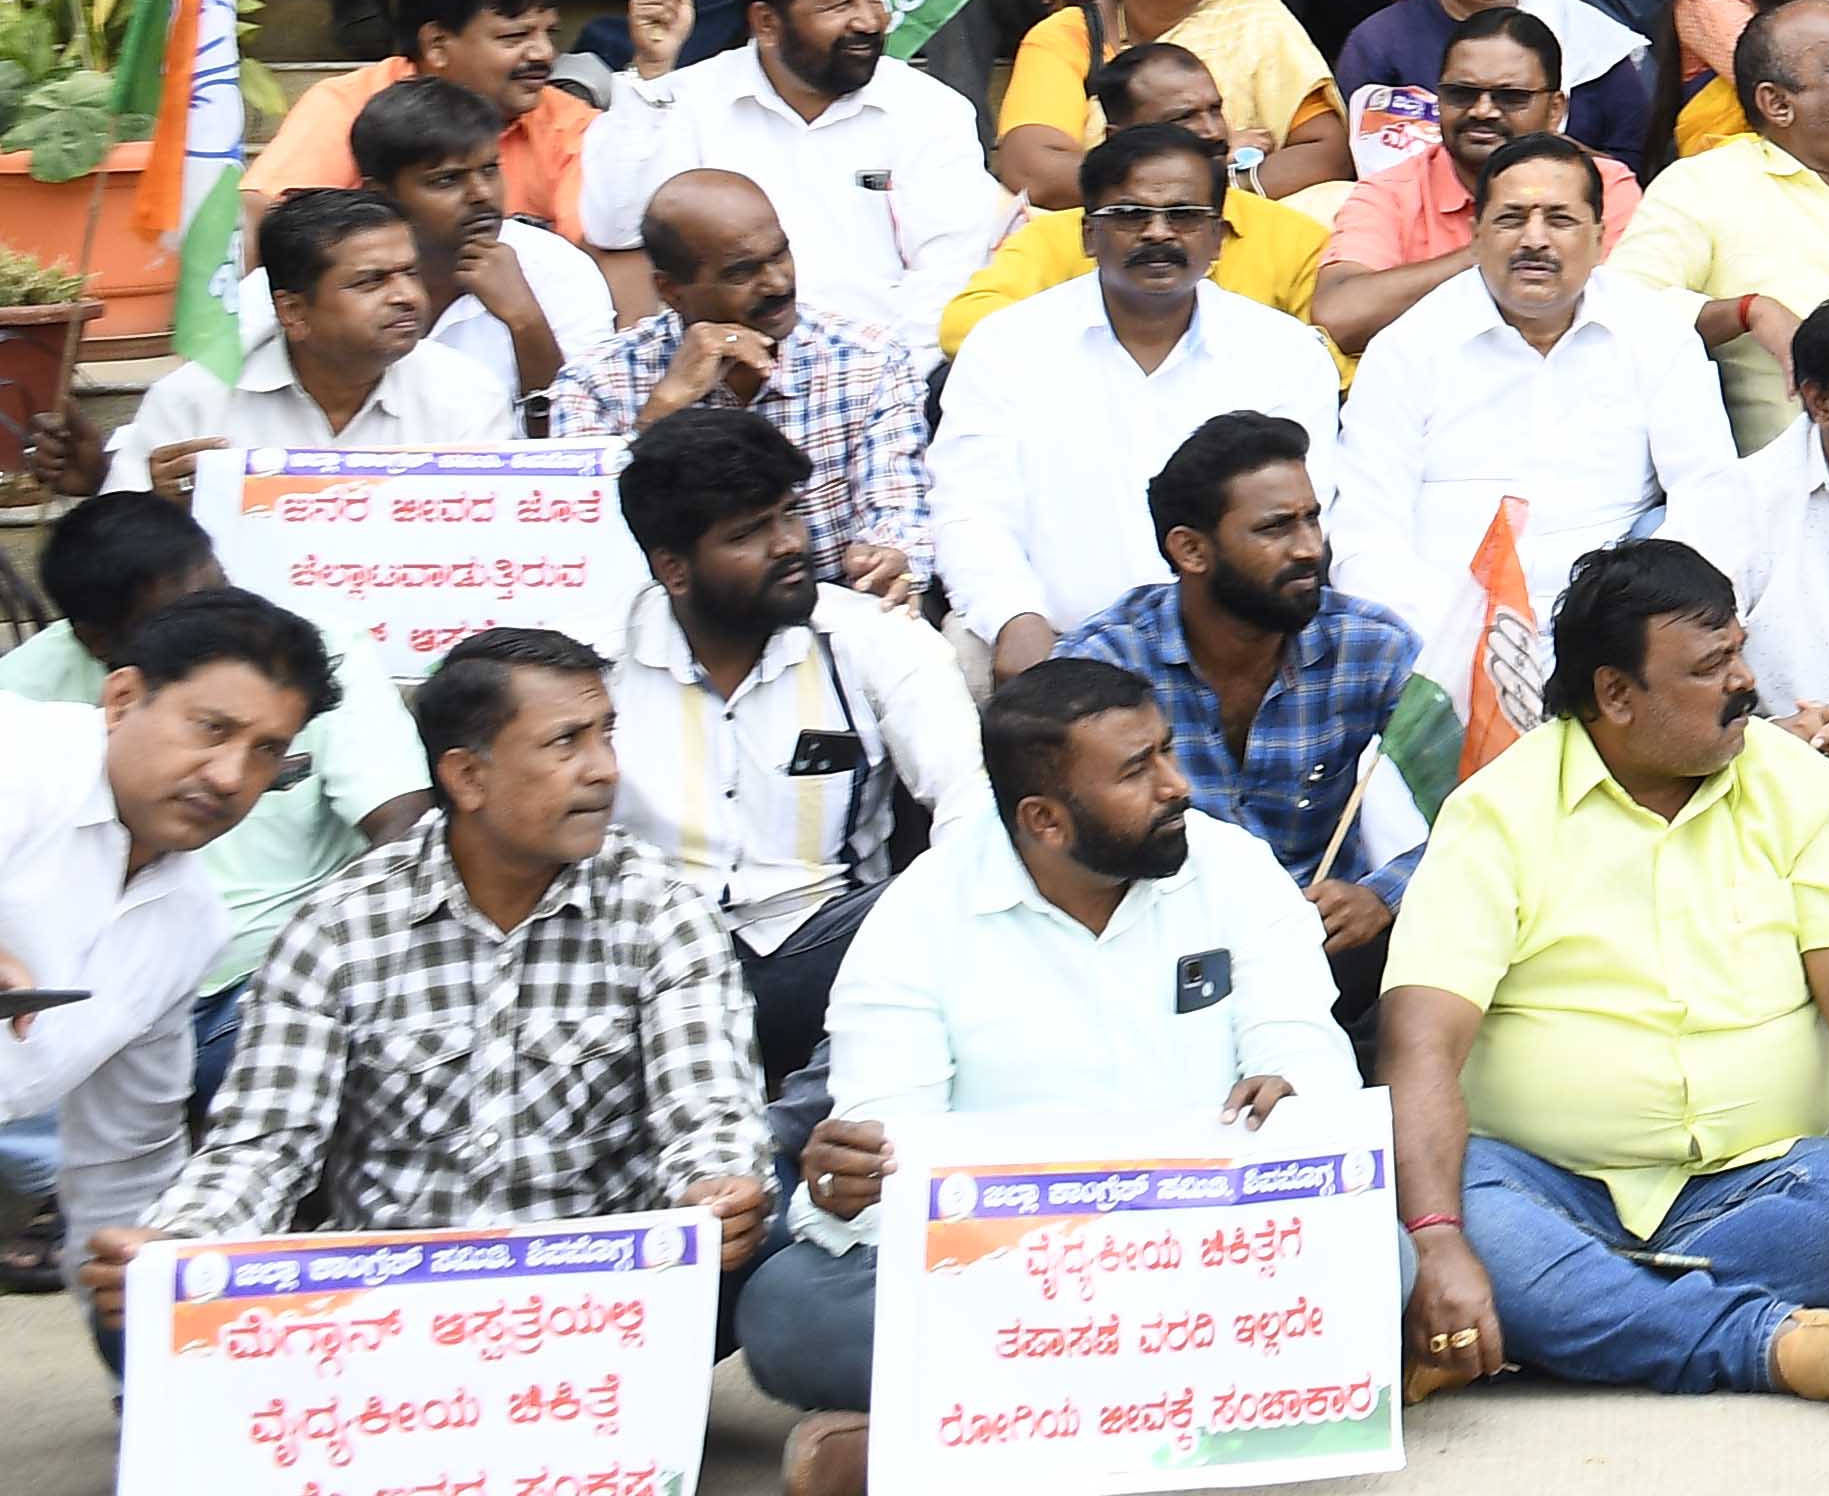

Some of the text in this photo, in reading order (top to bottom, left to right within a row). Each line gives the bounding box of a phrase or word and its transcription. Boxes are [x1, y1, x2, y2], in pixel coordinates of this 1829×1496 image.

[282, 489, 602, 524] ಜನರ ಜೀವದ ಜೊತೆ
[1025, 1217, 1303, 1301] ವೈದ್ಯಕೀಯ ಚಿಕಿತ್ಸೆಗೆ
[227, 1293, 647, 1376] ಮೆಗ್ಗಾನ್ ಆಸ್ಪತ್ರೆಯಲ್ಲಿ
[996, 1297, 1324, 1360] ತಪಾಸಣೆ ವರದಿ ಇಲ್ಲದೇ
[249, 1373, 623, 1466] ವೈದ್ಯಕೀಯ ಚಿಕಿತ್ಸೆ
[938, 1397, 1081, 1447] ರೋಗಿಯ
[1098, 1387, 1198, 1450] ಜೀವಕ್ಕೆ
